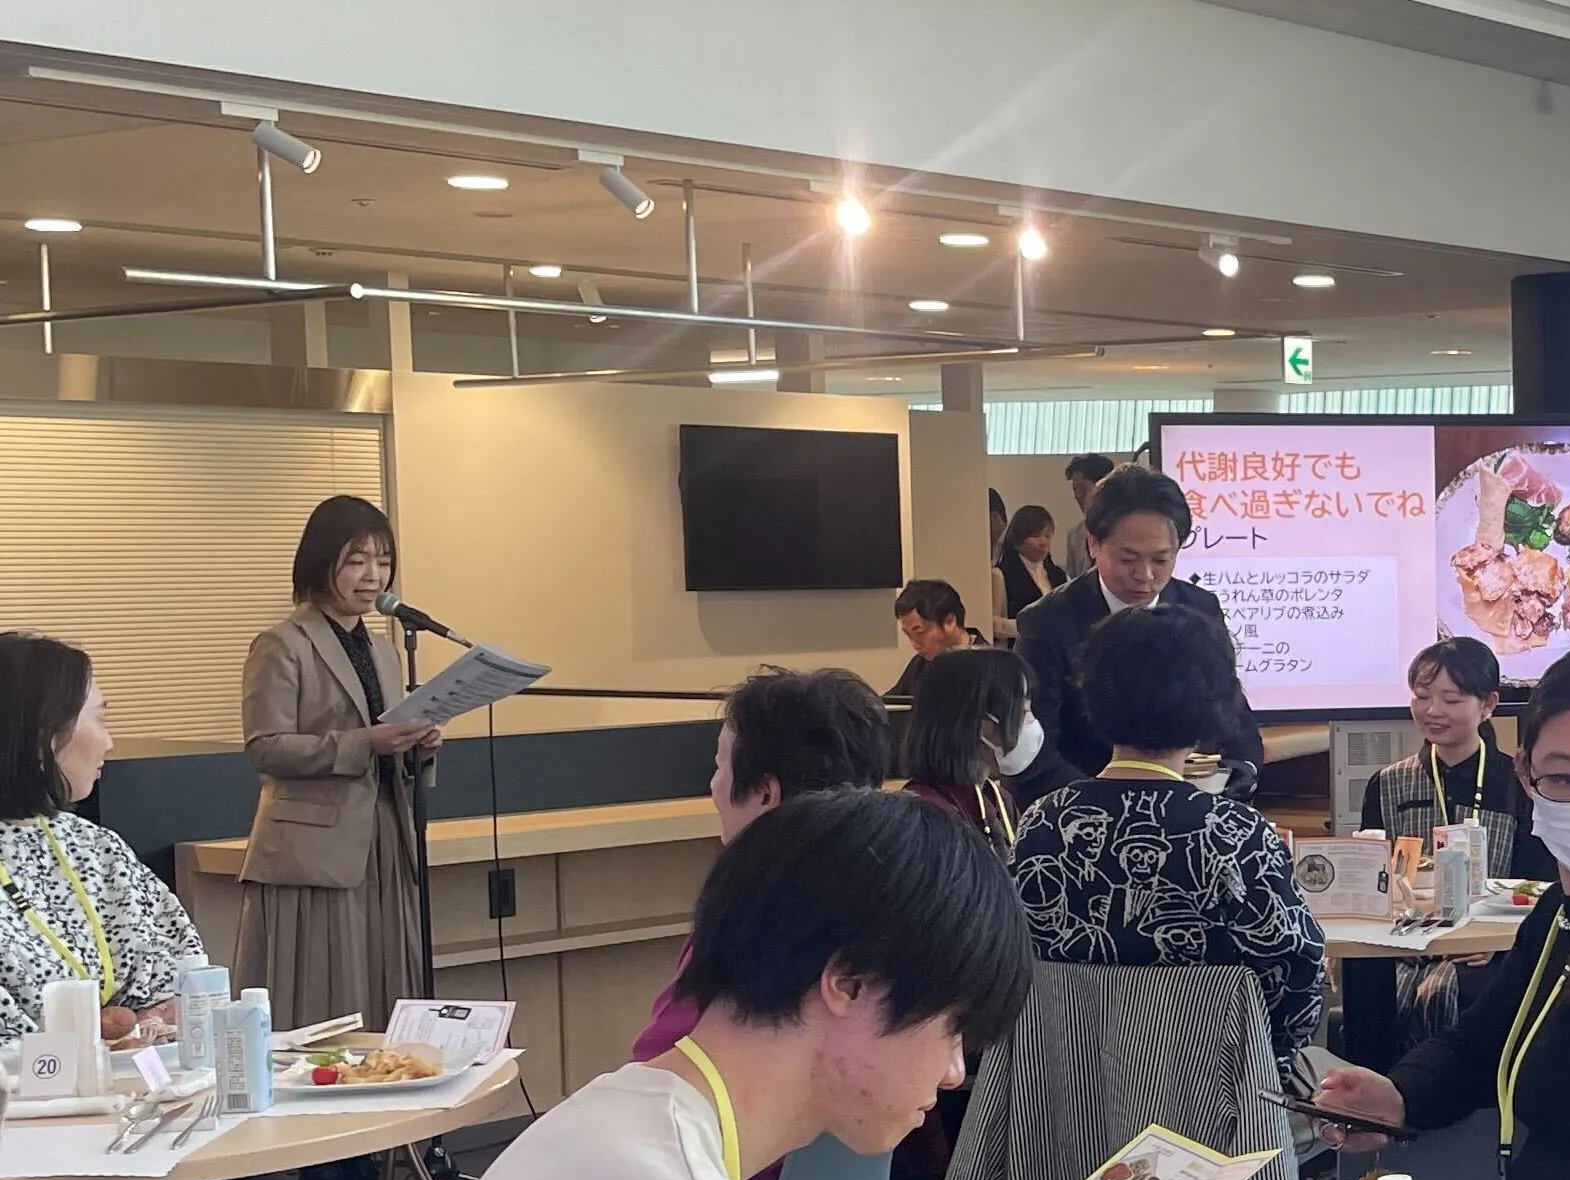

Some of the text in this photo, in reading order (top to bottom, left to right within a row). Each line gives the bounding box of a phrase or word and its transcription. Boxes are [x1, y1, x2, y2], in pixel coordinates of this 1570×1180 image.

[1176, 450, 1362, 483] 代謝良好でも
[1184, 488, 1426, 520] 食べ過ぎないでね
[1181, 525, 1269, 550] プレート
[1203, 569, 1370, 586] 生ハムとルッコラのサラダ
[1211, 587, 1344, 602] うれん草のポレンタ
[37, 1058, 57, 1075] 20
